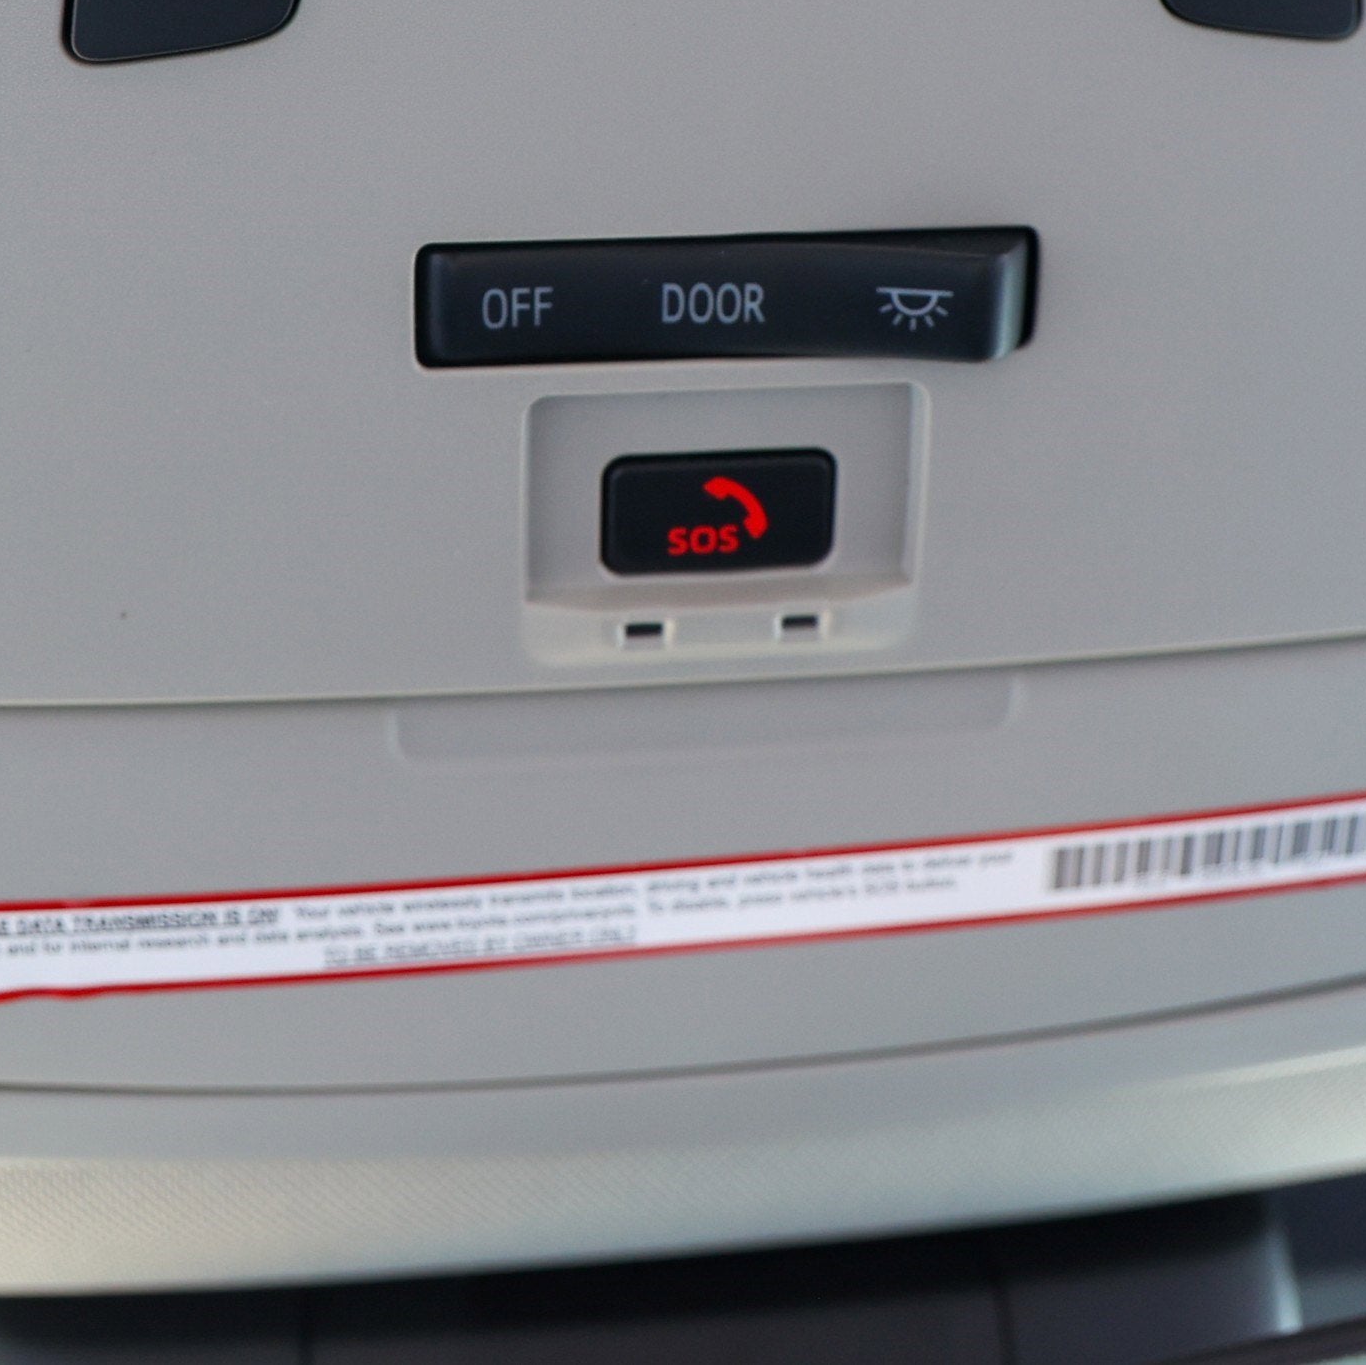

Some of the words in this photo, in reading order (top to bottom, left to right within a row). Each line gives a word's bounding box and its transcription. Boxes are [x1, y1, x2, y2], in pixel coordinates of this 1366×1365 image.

[481, 287, 554, 328] OFF
[661, 283, 766, 324] DOOR
[667, 525, 740, 555] SOS
